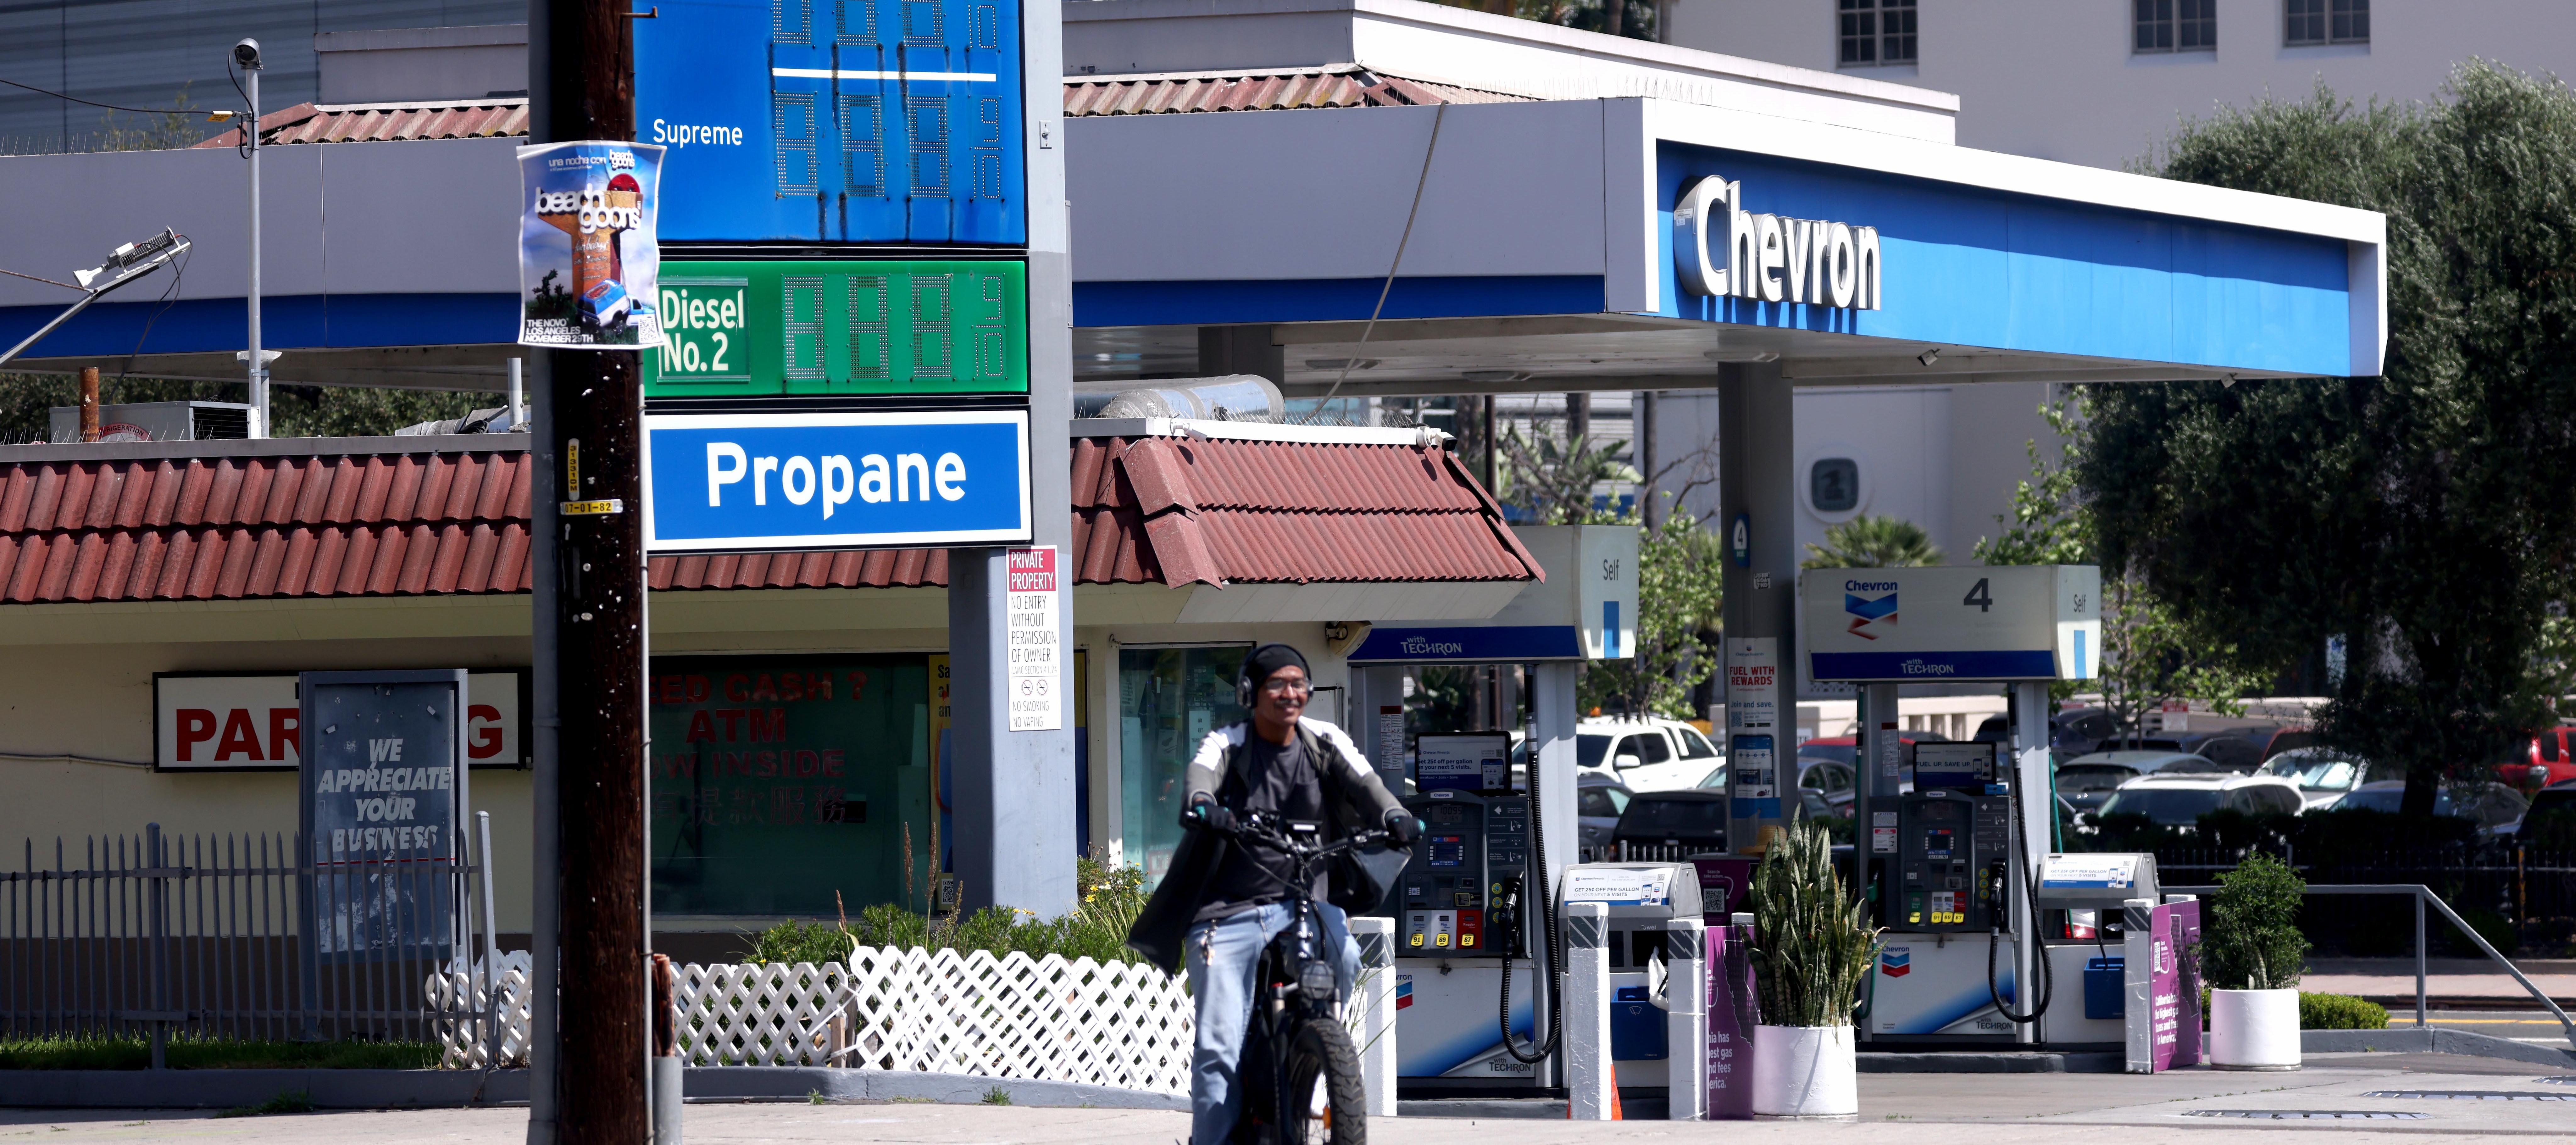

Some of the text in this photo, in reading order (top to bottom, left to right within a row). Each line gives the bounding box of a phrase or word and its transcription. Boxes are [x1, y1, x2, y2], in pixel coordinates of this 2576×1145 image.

[652, 118, 743, 148] Supreme
[565, 155, 589, 165] noche
[535, 183, 605, 213] beach
[579, 206, 641, 234] goons
[1674, 175, 1881, 311] Chevron
[663, 289, 744, 329] Diesel
[663, 332, 729, 372] No. 2
[707, 442, 966, 521] Propane
[565, 503, 611, 513] 07-01-82
[1738, 527, 1743, 546] 4
[1011, 551, 1043, 568] PRIVATE
[1603, 559, 1619, 581] Self
[1011, 572, 1053, 590] PROPERTY
[1011, 595, 1046, 609] NO ENTRY
[1846, 578, 1993, 612] Chevron 4
[2074, 594, 2086, 614] Self
[1011, 613, 1044, 627] WITHOUT
[1012, 631, 1056, 645] PERMISSION
[1407, 636, 1425, 644] with
[1400, 641, 1462, 655] TECHRON
[1012, 648, 1051, 663] OF OWNER
[1012, 665, 1057, 674] LAMC SECTION 41.24
[1729, 666, 1775, 675] FUEL WITH
[1901, 663, 1954, 675] TECHRON
[725, 672, 832, 702] CASH
[1731, 676, 1773, 686] REWARDS
[1013, 701, 1049, 712] NO SMOKING
[686, 708, 786, 744] ATM
[1013, 716, 1043, 727] NO VAPING
[369, 738, 403, 762] WE
[712, 750, 845, 779] INSIDE
[317, 766, 452, 793] APPRECIATE
[355, 797, 416, 822] YOUR
[332, 825, 438, 853] BUSINESS
[2155, 993, 2170, 1006] California
[2160, 1007, 2173, 1020] highest
[1976, 1021, 2012, 1030] TECHRON
[1718, 1031, 1729, 1043] has
[2157, 1035, 2160, 1045] in
[1721, 1048, 1732, 1060] gas
[1489, 1062, 1531, 1073] TECHRON
[1718, 1061, 1731, 1073] fees
